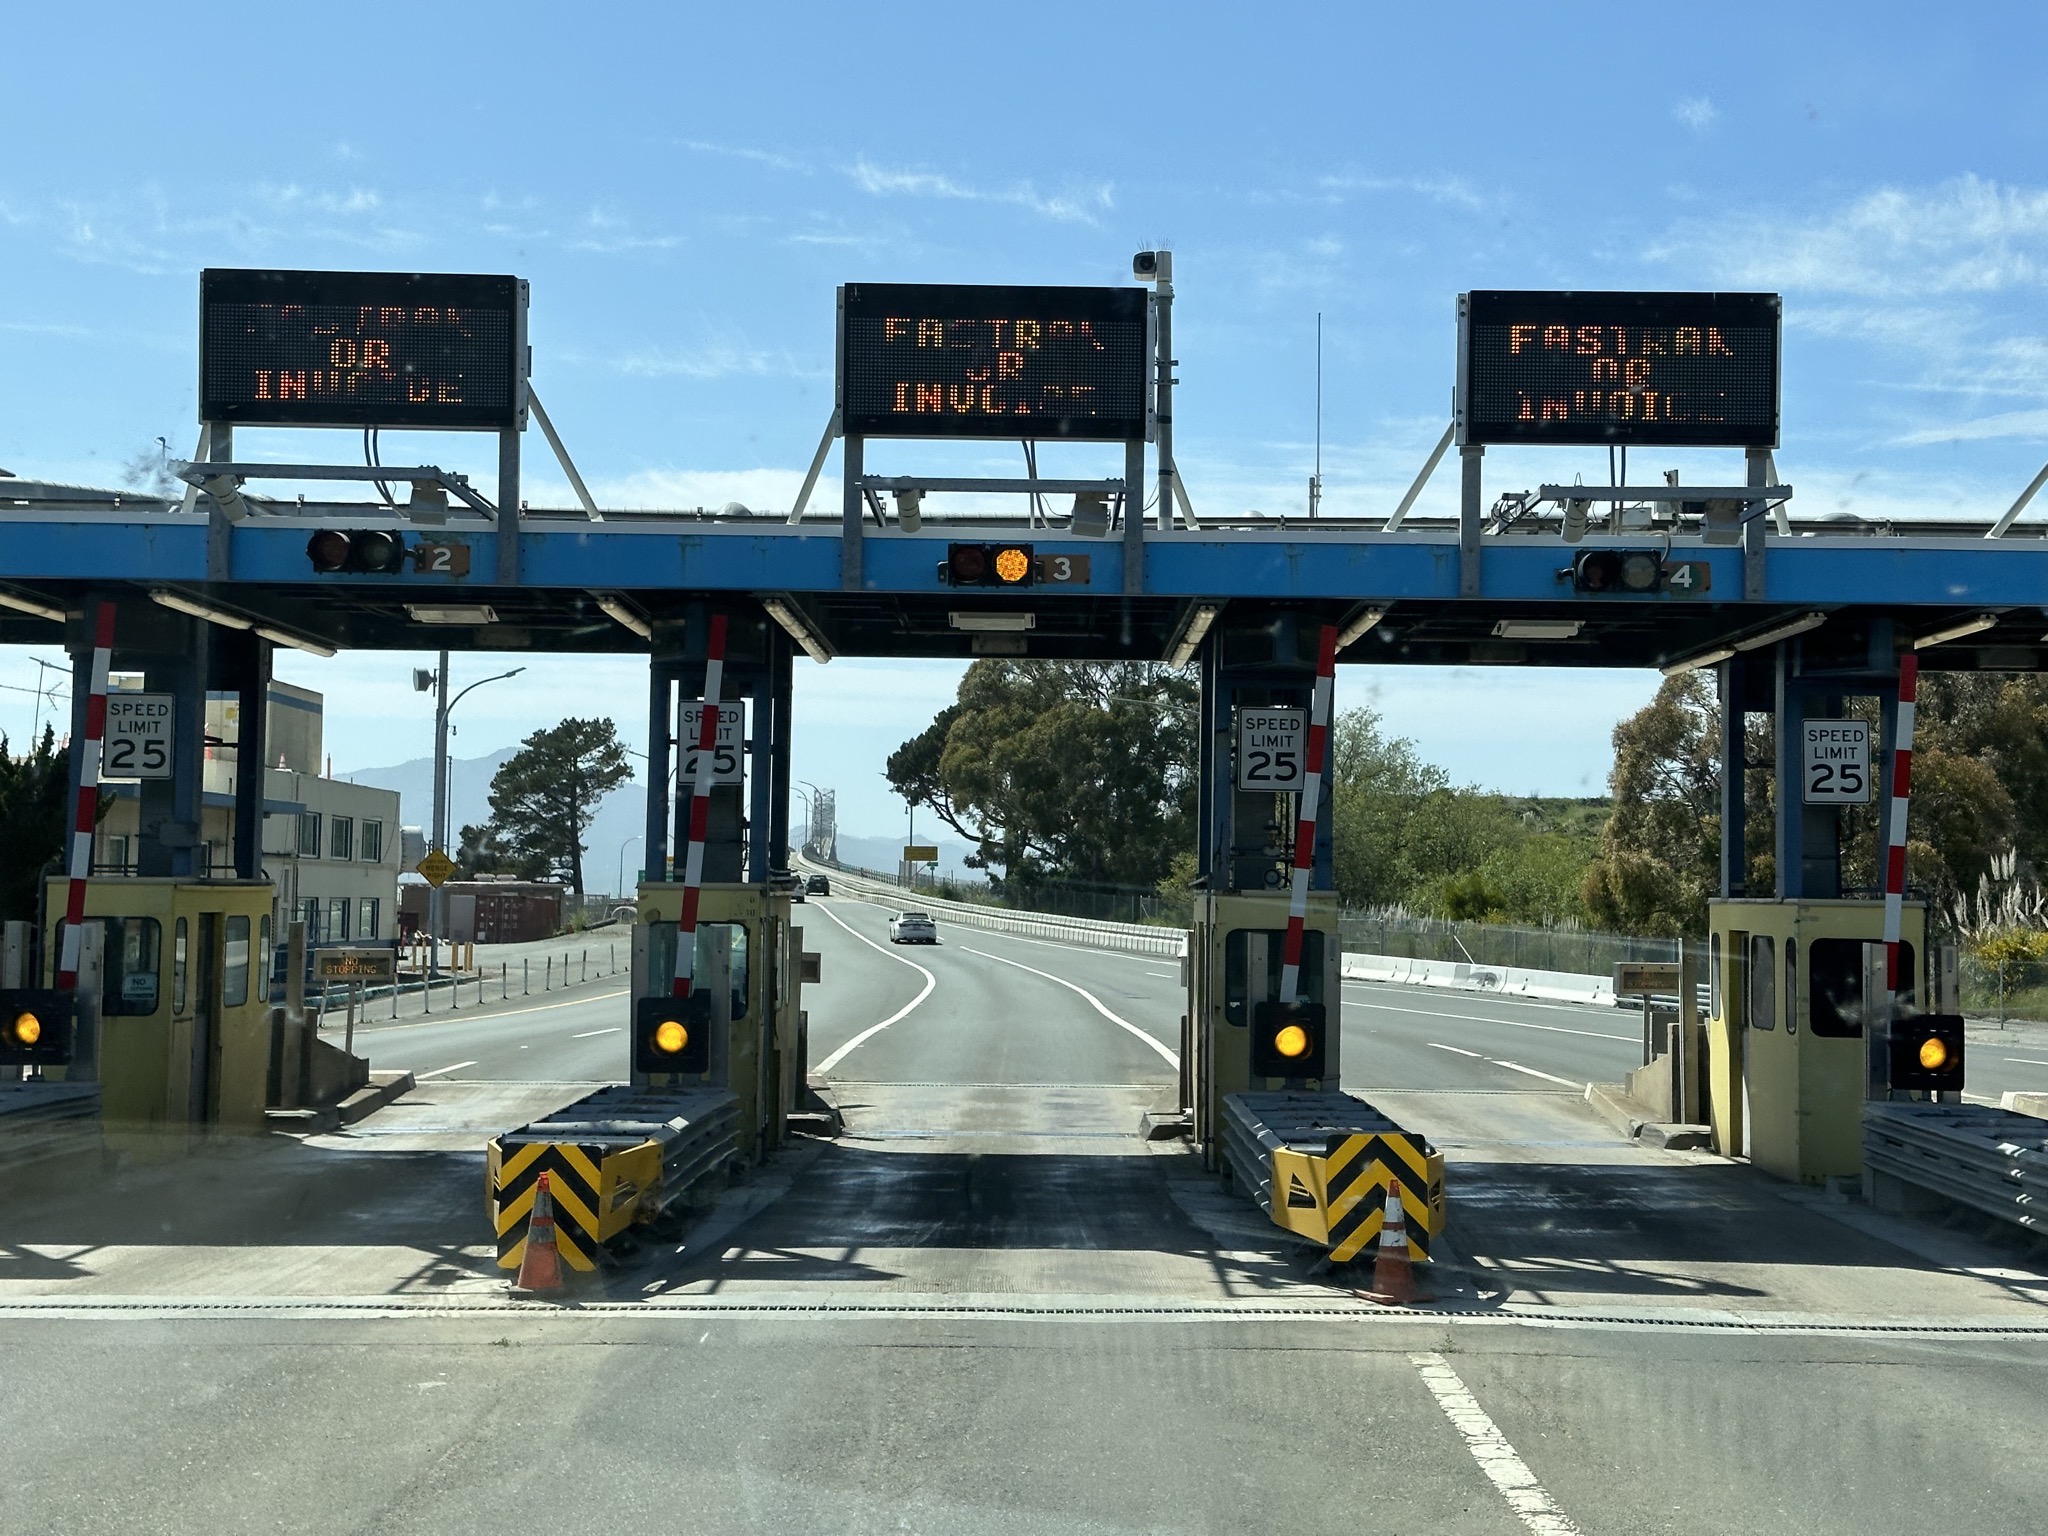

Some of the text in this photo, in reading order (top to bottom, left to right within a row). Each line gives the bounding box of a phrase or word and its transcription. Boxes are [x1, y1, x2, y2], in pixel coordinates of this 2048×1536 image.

[330, 338, 390, 369] OR
[431, 547, 452, 571] 2
[1052, 557, 1072, 581] 3
[1669, 564, 1693, 588] 4
[110, 703, 168, 717] SPEED
[684, 710, 739, 723] SPED
[118, 720, 161, 734] LIMIT
[1245, 717, 1301, 731] SPEED
[689, 727, 732, 740] LIT
[1251, 734, 1294, 747] LIMIT
[1808, 729, 1864, 742] SPEED
[110, 738, 167, 769] 25
[1814, 746, 1858, 759] LIMIT
[1246, 750, 1298, 781] 25
[1810, 763, 1863, 794] 25
[345, 957, 358, 966] NO
